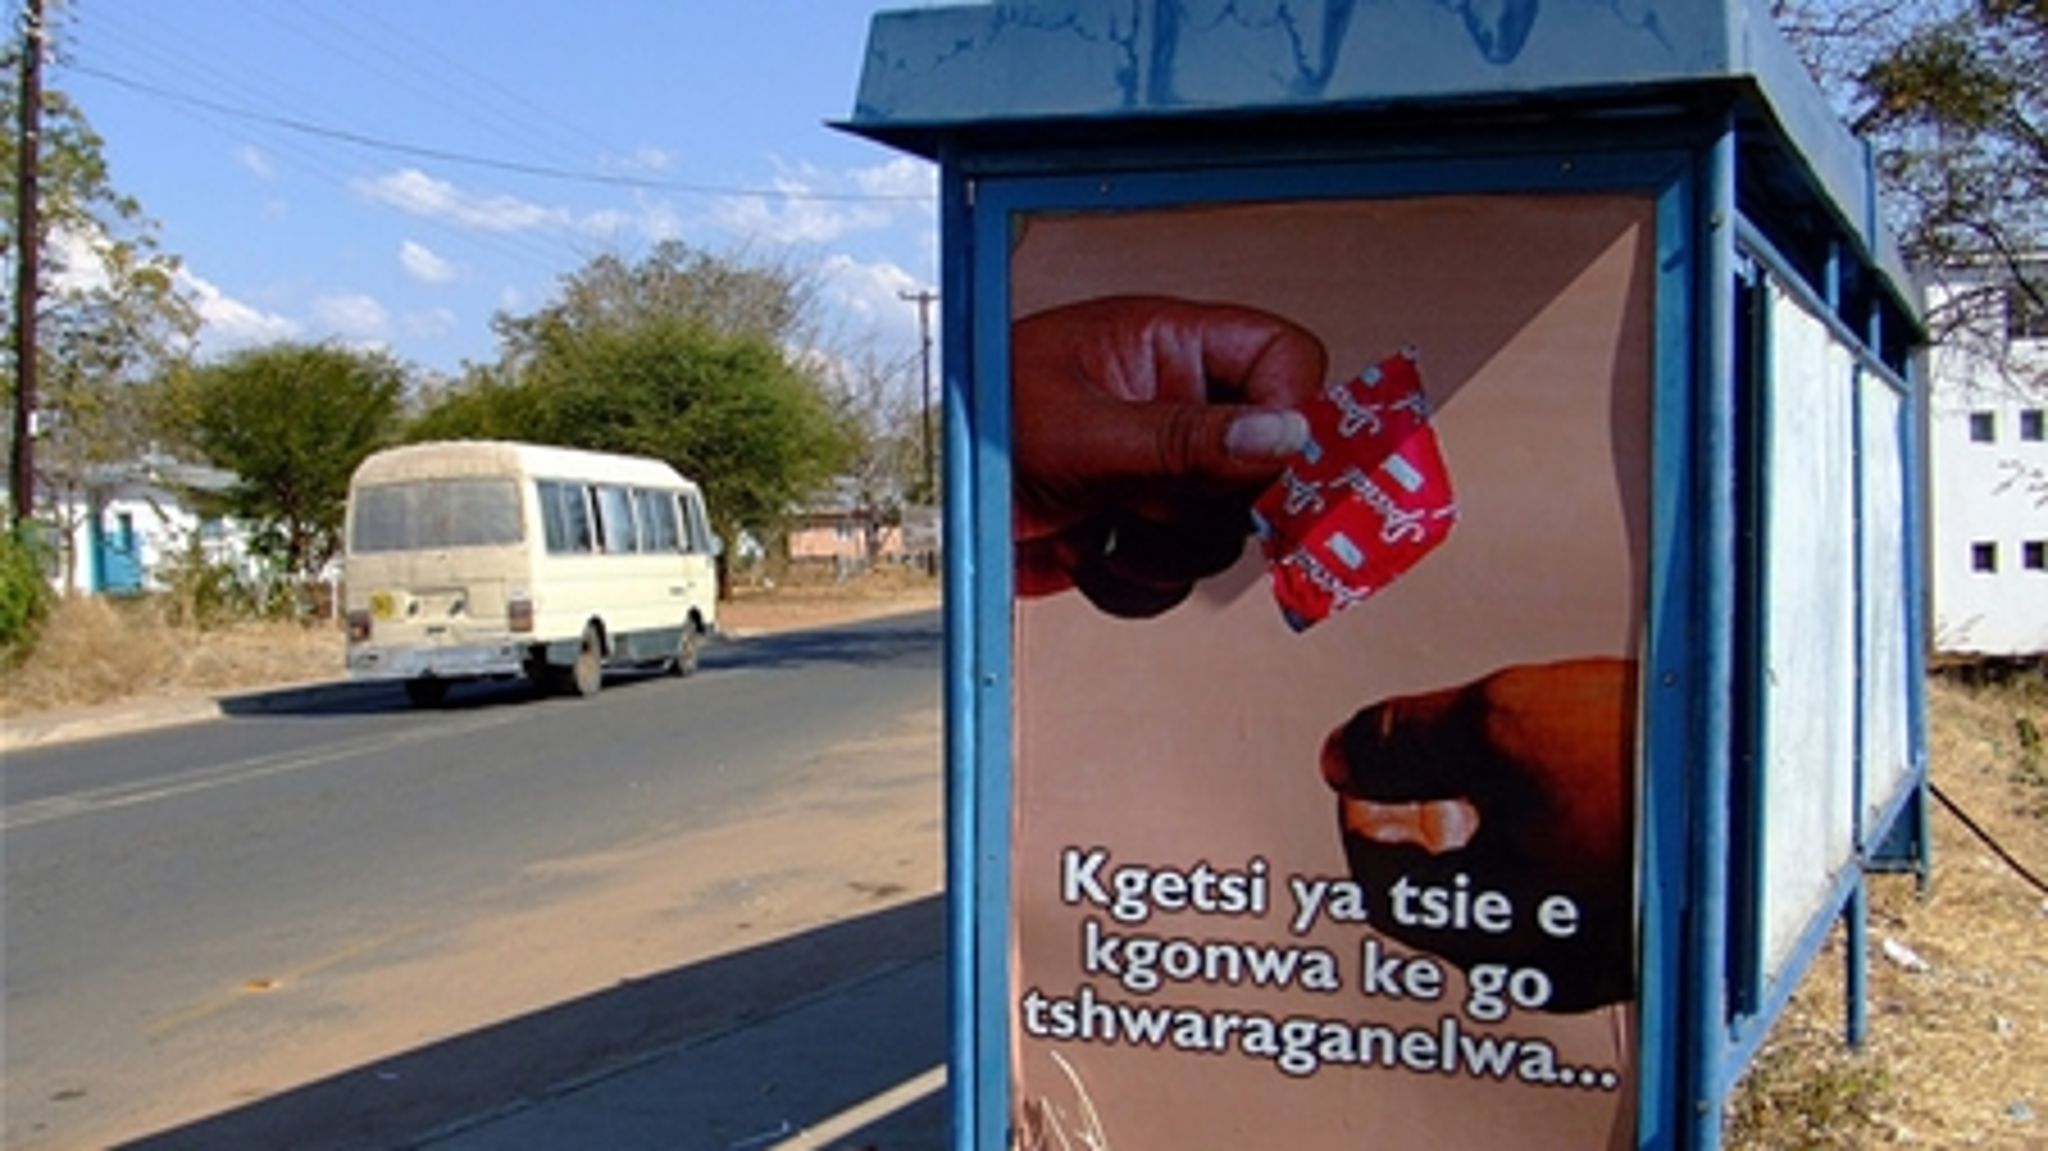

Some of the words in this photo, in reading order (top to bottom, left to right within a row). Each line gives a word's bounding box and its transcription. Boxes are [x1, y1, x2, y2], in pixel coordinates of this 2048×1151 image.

[1063, 849, 1266, 922] Kgetsi
[1291, 877, 1368, 931] ya
[1390, 873, 1512, 931] tsie
[1537, 894, 1580, 937] e
[1084, 921, 1339, 990] kgonwa
[1363, 938, 1442, 999] ke
[1467, 964, 1552, 1018] go
[1023, 988, 1617, 1088] tshwaraganelwa...
